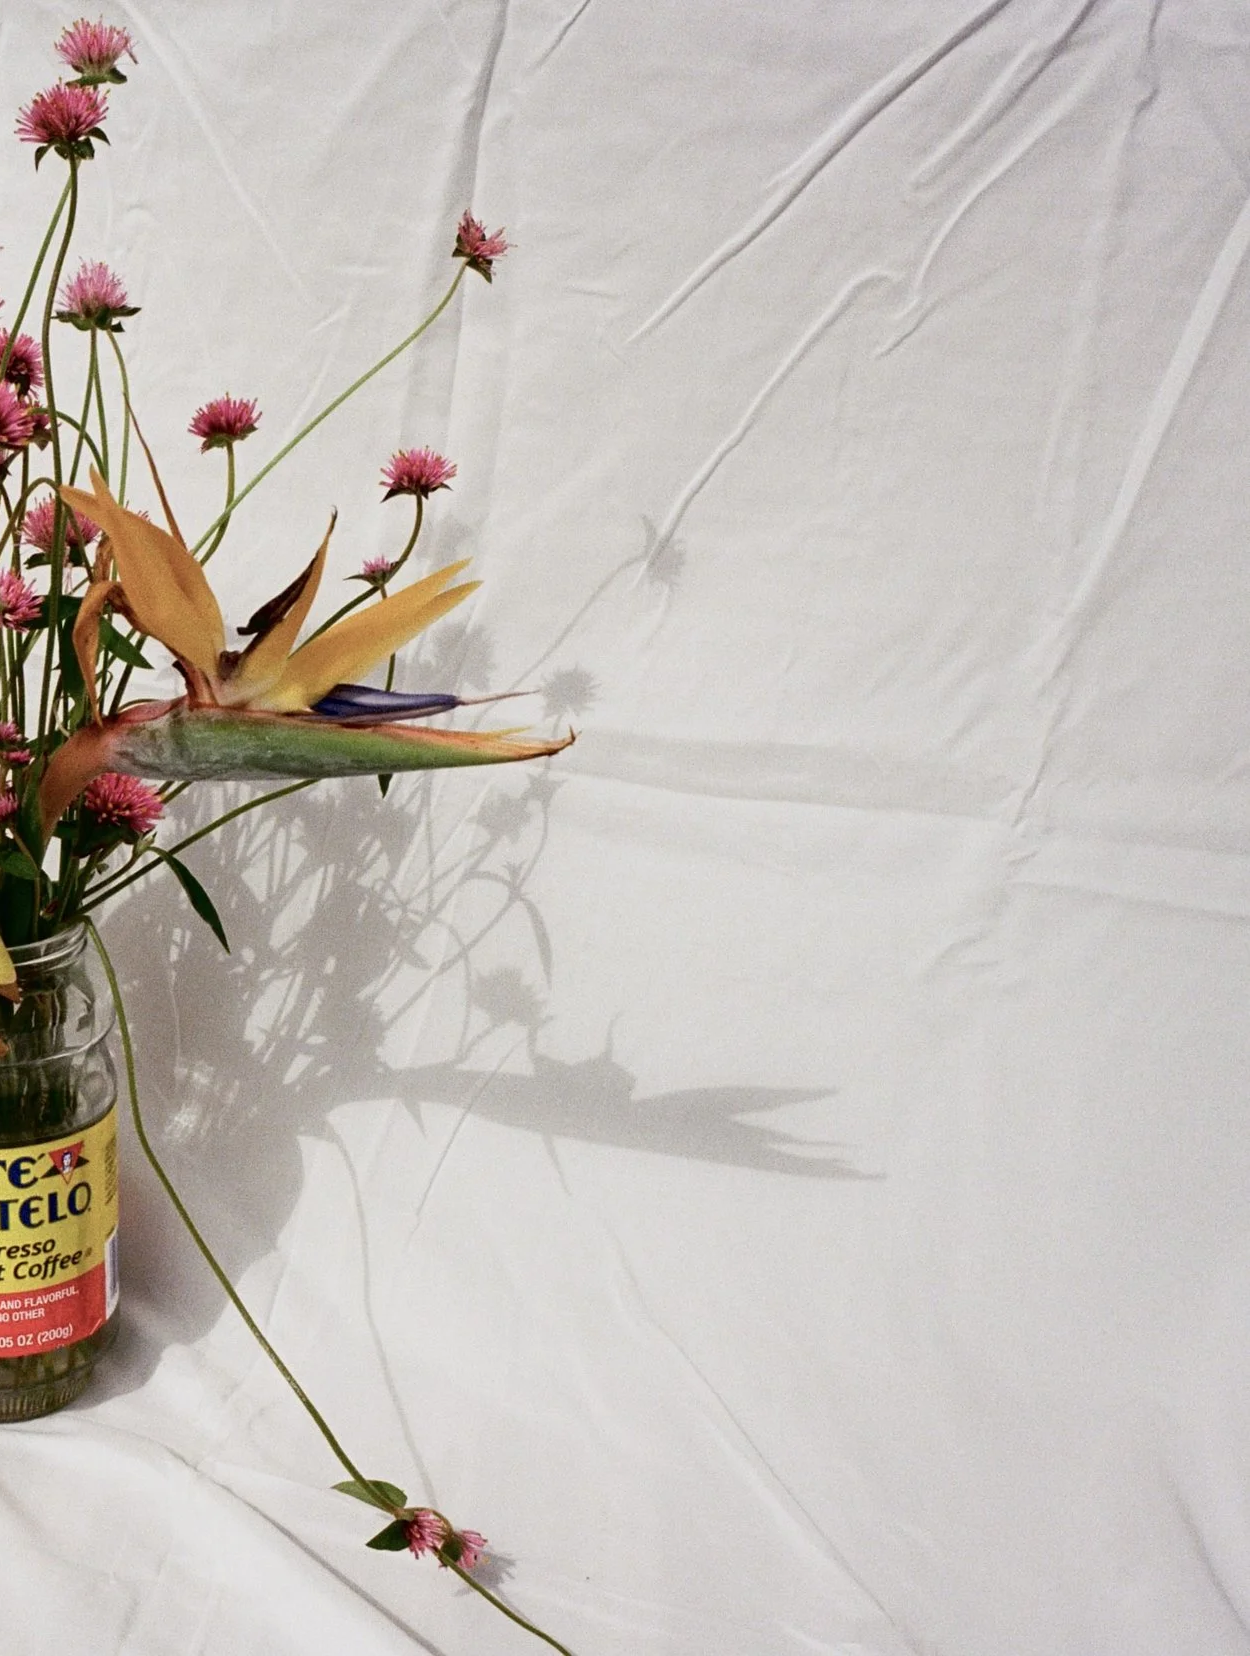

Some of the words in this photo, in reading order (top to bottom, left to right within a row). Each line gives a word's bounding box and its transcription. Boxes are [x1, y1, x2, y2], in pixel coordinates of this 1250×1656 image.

[13, 1249, 83, 1281] Coffee
[0, 1300, 22, 1309] AND
[12, 1308, 45, 1321] OTHER
[17, 1333, 34, 1347] OZ
[37, 1323, 74, 1345] (200g)
